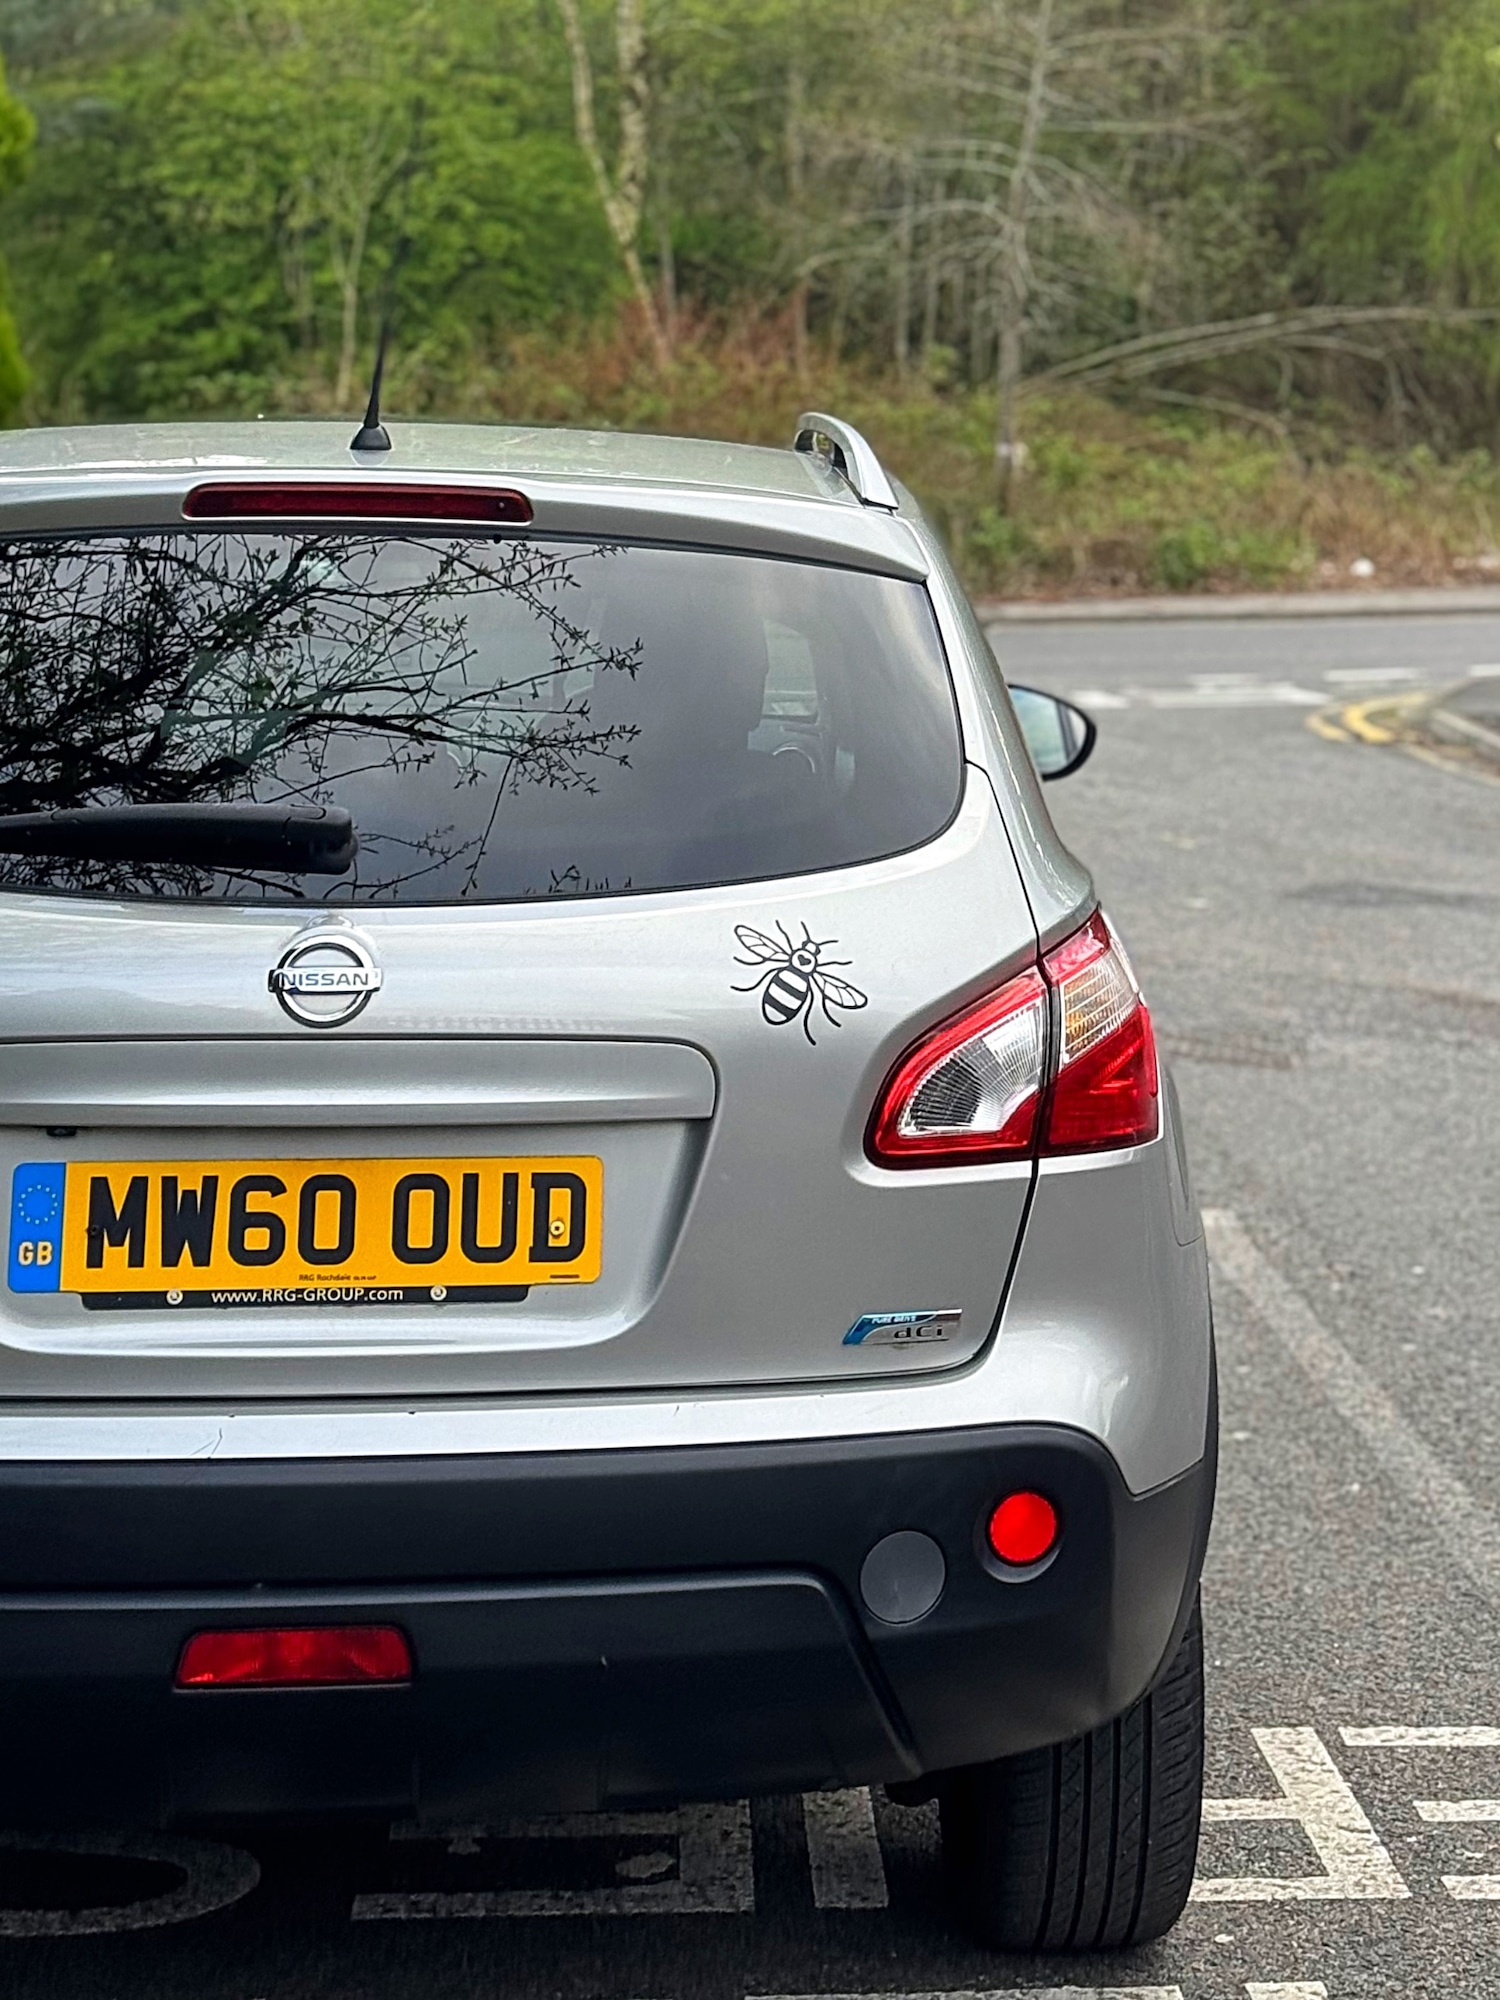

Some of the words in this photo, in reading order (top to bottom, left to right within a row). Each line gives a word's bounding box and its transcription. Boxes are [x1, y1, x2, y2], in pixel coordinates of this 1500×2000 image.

[281, 972, 368, 986] NISSAN
[86, 1174, 356, 1269] MW60
[391, 1172, 587, 1264] OUD
[18, 1241, 53, 1266] GB
[298, 1273, 315, 1281] RRG
[211, 1288, 403, 1303] www.RRG-GROUP.com
[894, 1325, 942, 1338] dCi
